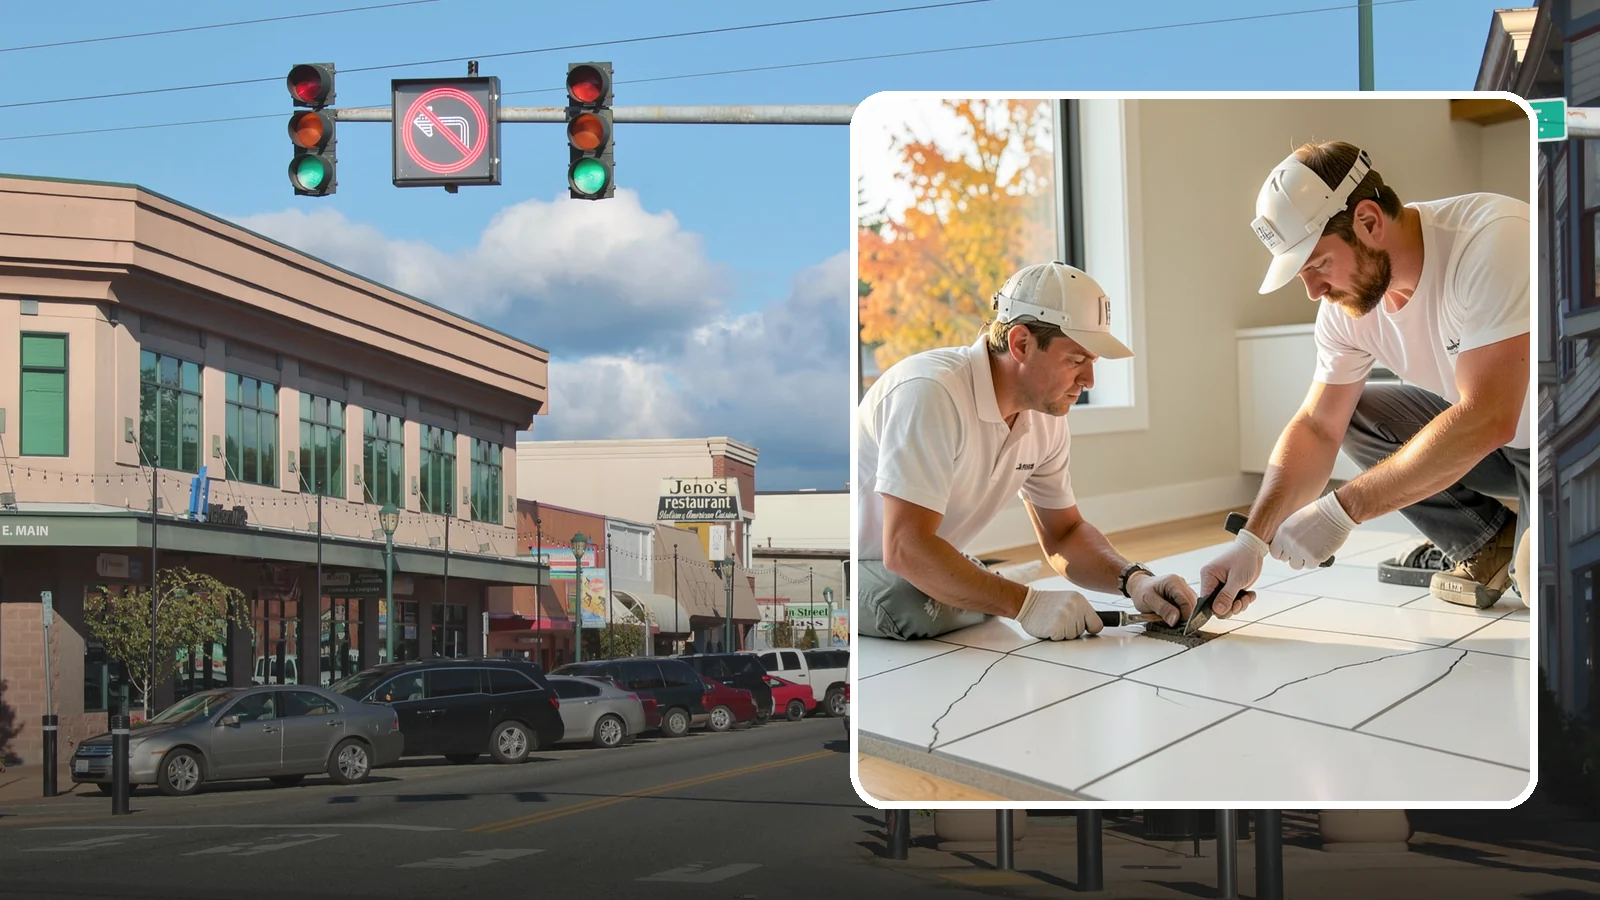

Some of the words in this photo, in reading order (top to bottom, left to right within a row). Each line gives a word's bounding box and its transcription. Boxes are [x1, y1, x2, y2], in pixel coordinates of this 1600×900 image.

[670, 480, 728, 495] Jeno's
[665, 496, 731, 509] restaurant
[659, 510, 681, 520] Italian
[686, 510, 714, 520] American
[715, 510, 738, 519] Cuisine
[2, 525, 13, 536] E.
[15, 525, 49, 536] MAIN
[786, 607, 795, 617] in
[797, 608, 828, 617] Street
[791, 619, 824, 627] lass
